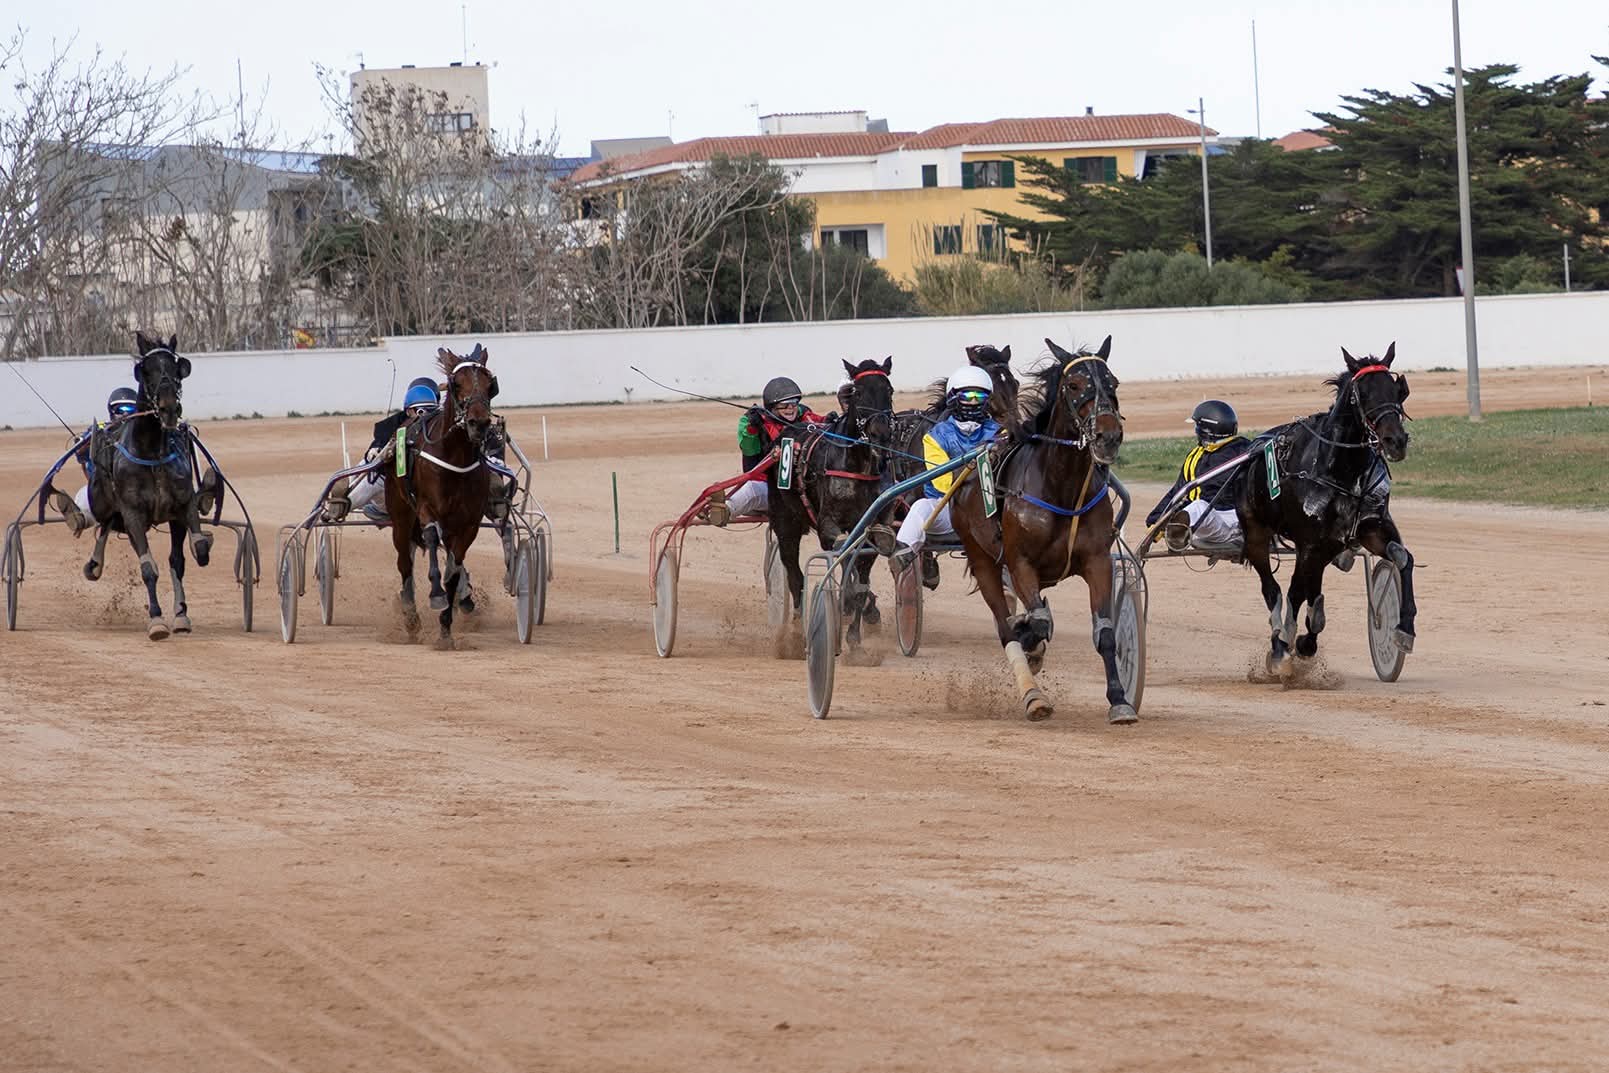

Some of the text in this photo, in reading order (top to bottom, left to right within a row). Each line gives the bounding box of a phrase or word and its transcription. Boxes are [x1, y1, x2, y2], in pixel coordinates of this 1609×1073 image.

[781, 444, 790, 480] 9
[1268, 451, 1278, 489] 2
[982, 462, 993, 504] 6
